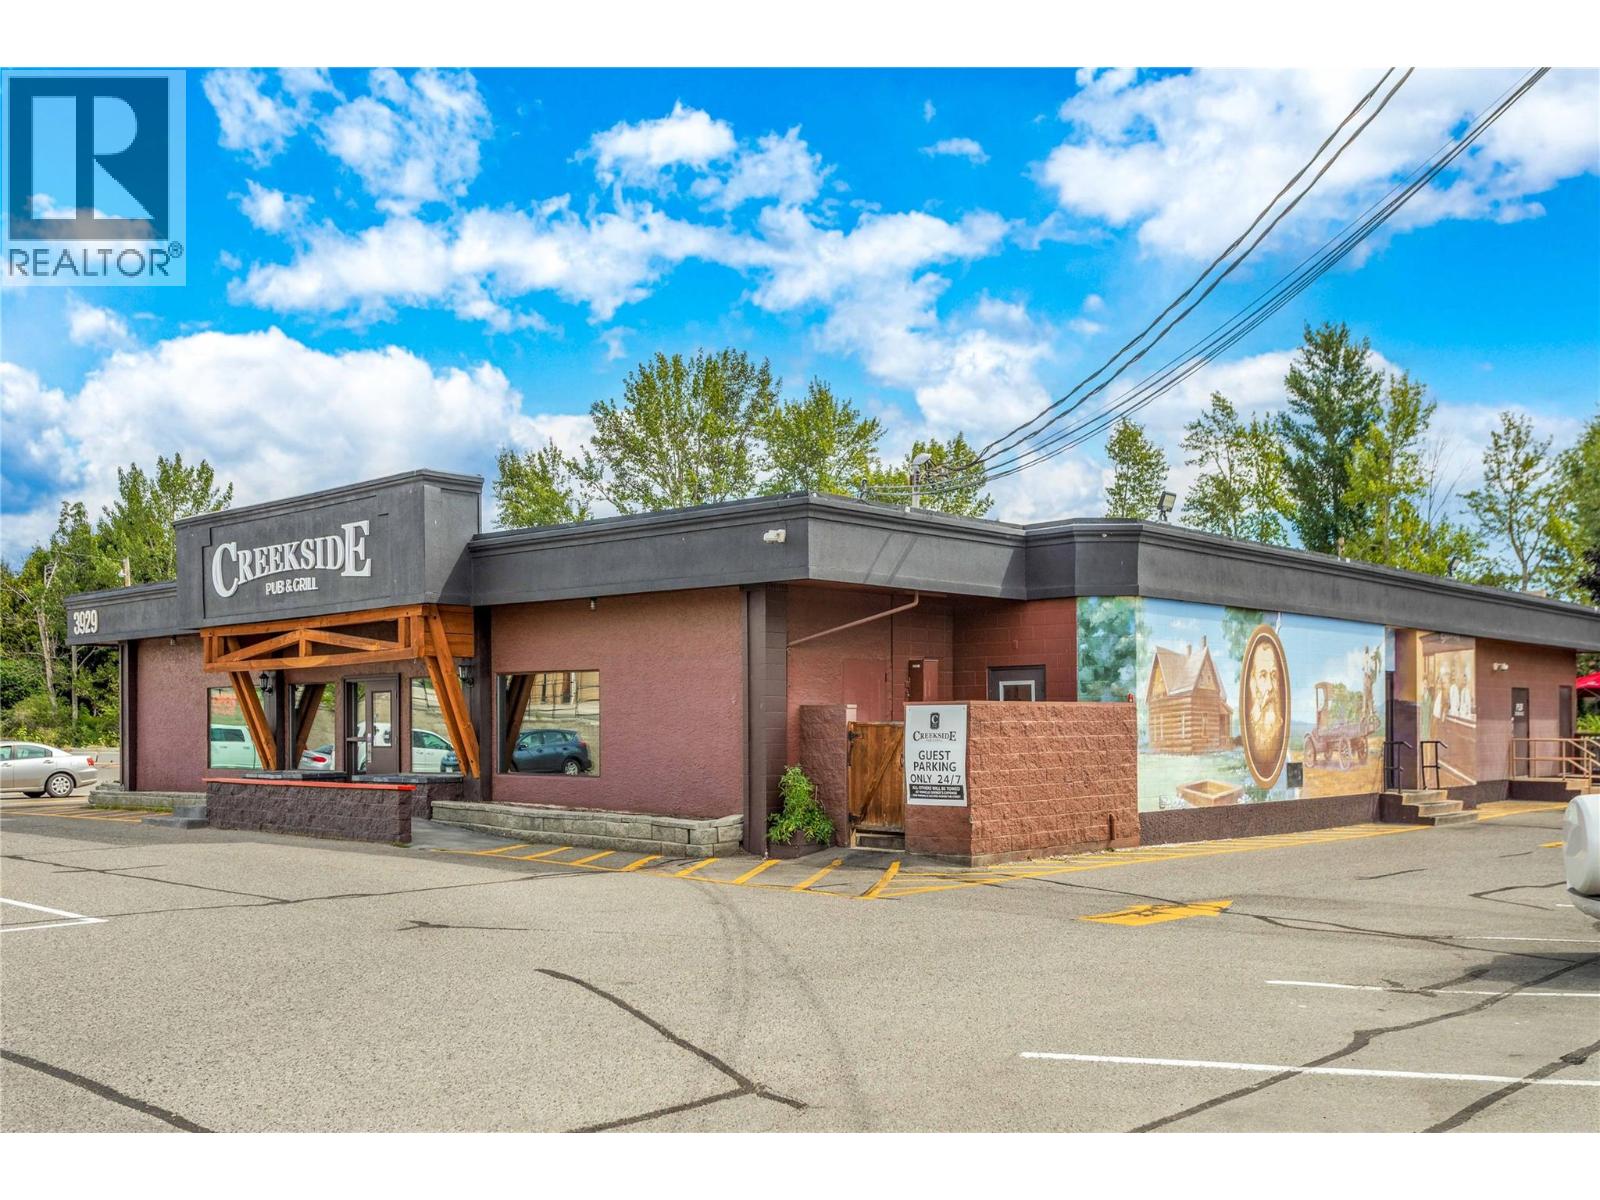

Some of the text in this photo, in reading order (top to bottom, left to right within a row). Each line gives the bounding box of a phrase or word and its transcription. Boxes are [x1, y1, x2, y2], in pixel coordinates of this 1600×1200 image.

[212, 520, 372, 598] CREEKSIDE
[73, 609, 99, 635] 3929
[912, 730, 957, 742] CREEKSIDE
[918, 750, 951, 761] GUEST
[913, 761, 957, 772] PARKING
[910, 773, 961, 785] ONLY 24/7
